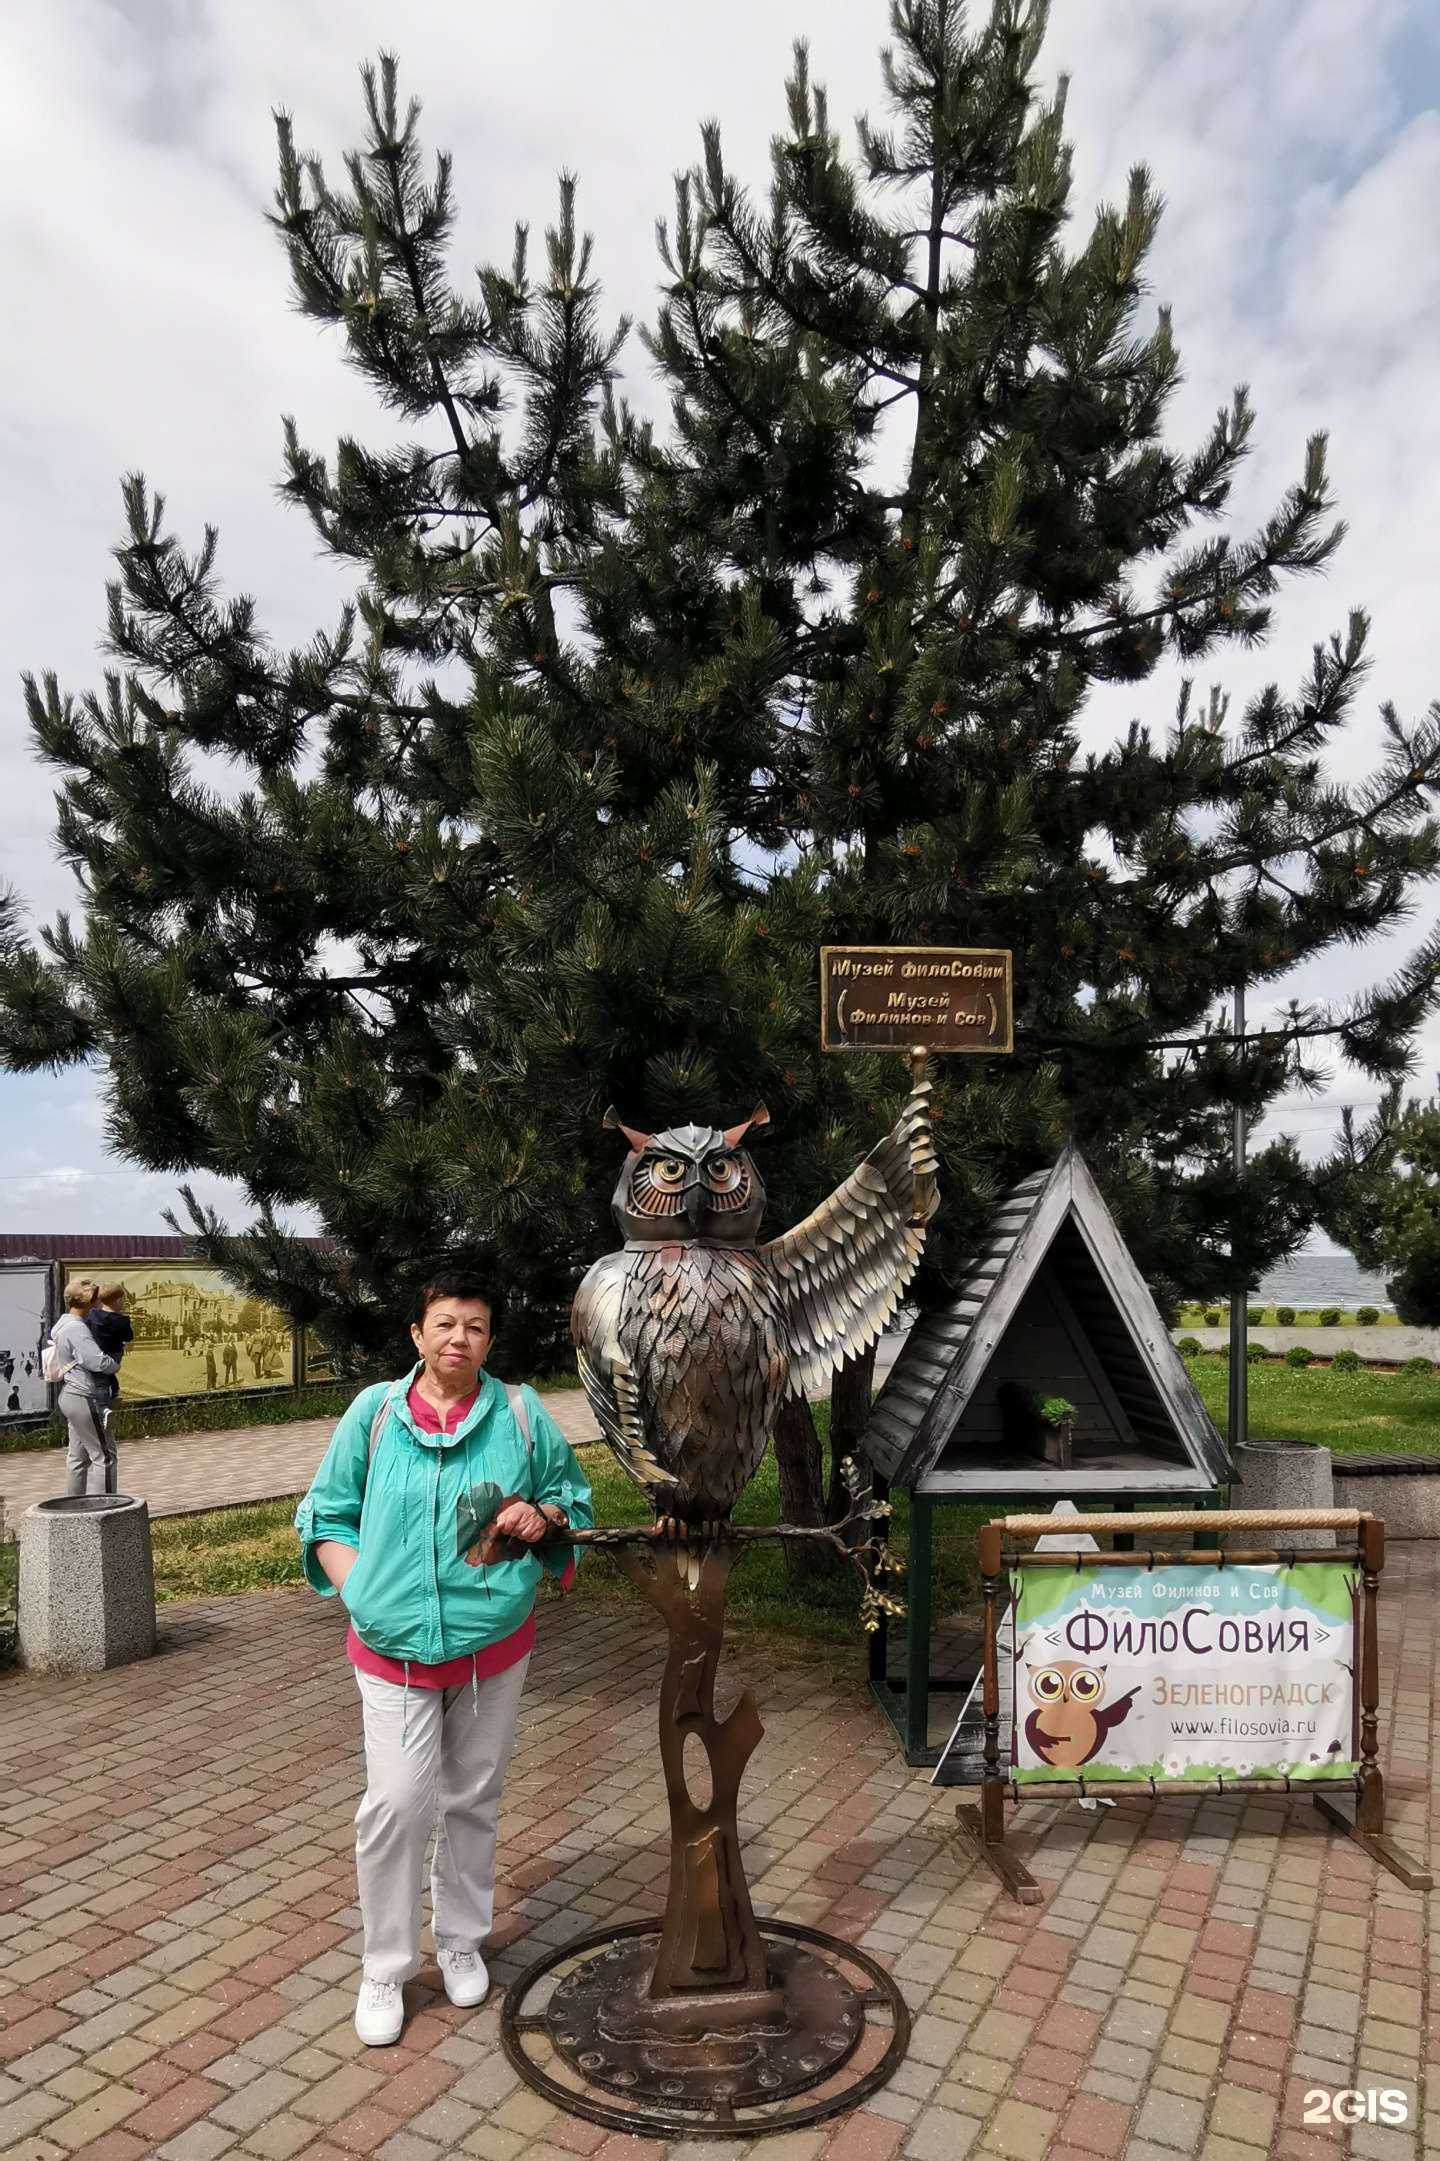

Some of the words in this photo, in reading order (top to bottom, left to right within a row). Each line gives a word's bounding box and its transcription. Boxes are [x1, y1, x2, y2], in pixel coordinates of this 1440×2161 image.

[832, 958, 894, 980] Музей
[888, 992, 950, 1011] Музей
[850, 1008, 932, 1025] Филинов
[936, 1013, 947, 1024] и
[954, 1010, 987, 1025] Сов
[1171, 1717, 1317, 1736] www.filosovia.ru
